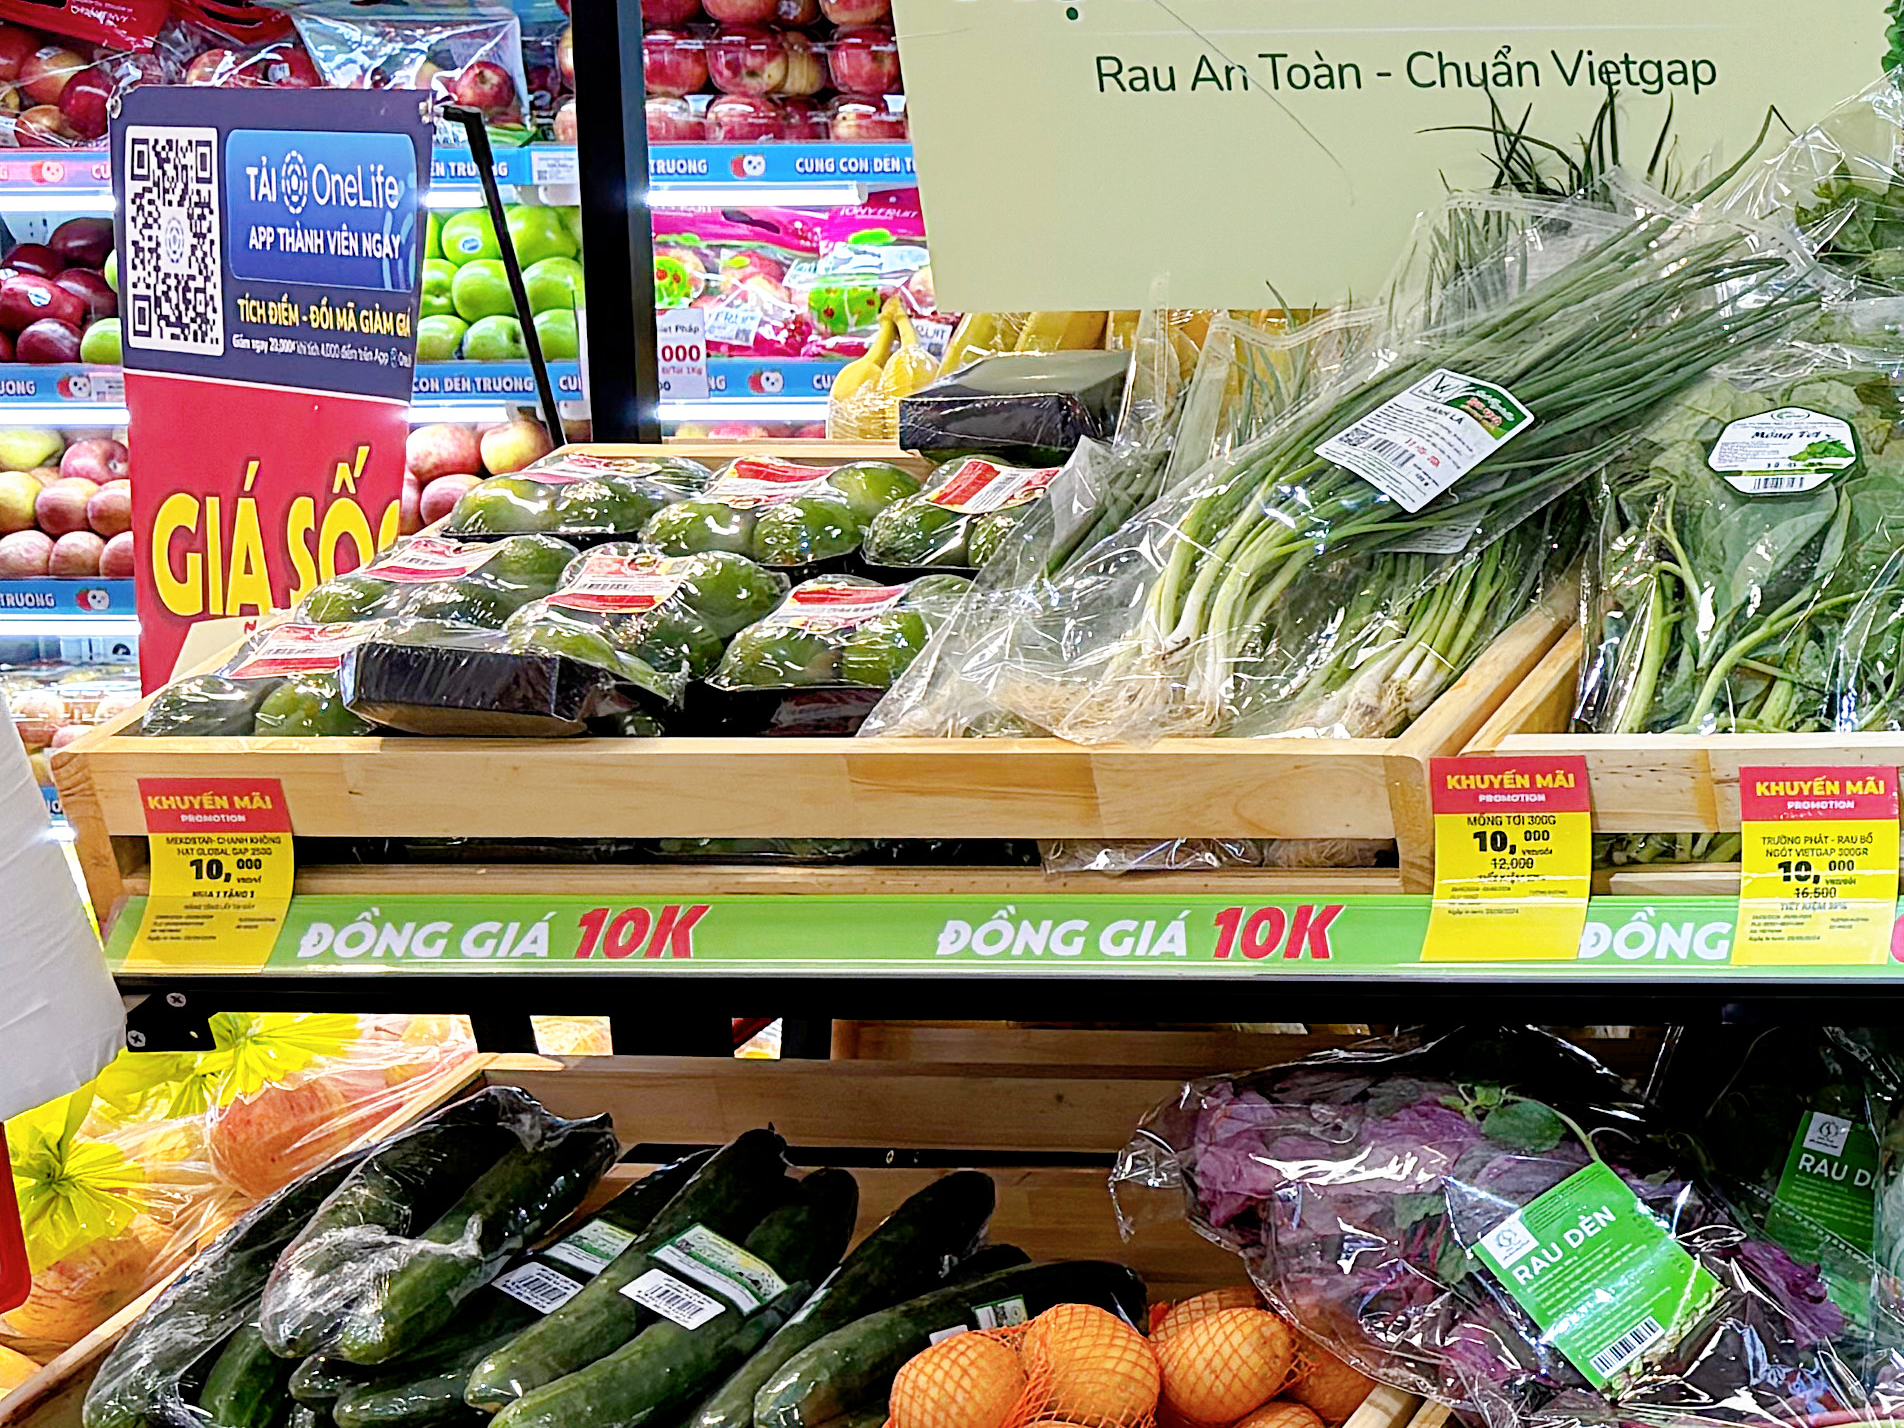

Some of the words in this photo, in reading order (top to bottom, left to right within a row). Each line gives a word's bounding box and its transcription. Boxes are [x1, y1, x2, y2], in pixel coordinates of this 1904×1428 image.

[1094, 53, 1177, 94] Rau
[1184, 53, 1250, 92] An
[1258, 46, 1364, 93] Toàn
[1404, 42, 1541, 92] Chuẩn
[1549, 48, 1718, 102] Vietgap
[244, 155, 277, 203] TẢI
[312, 160, 400, 210] OneLife
[248, 226, 275, 251] APP
[326, 226, 360, 258] VIÊN
[151, 459, 274, 617] GIÁ
[1446, 769, 1530, 790] KHUYẾN
[1535, 770, 1575, 789] MÃI
[298, 905, 453, 960] ĐỒNG
[460, 910, 558, 959] GIÁ
[573, 903, 713, 961] 10K
[936, 904, 1090, 961] ĐỒNG
[1097, 908, 1190, 959] GIÁ
[1211, 903, 1346, 960] 10K
[1577, 905, 1731, 962] ĐỒNG
[1511, 1241, 1564, 1286] RAU
